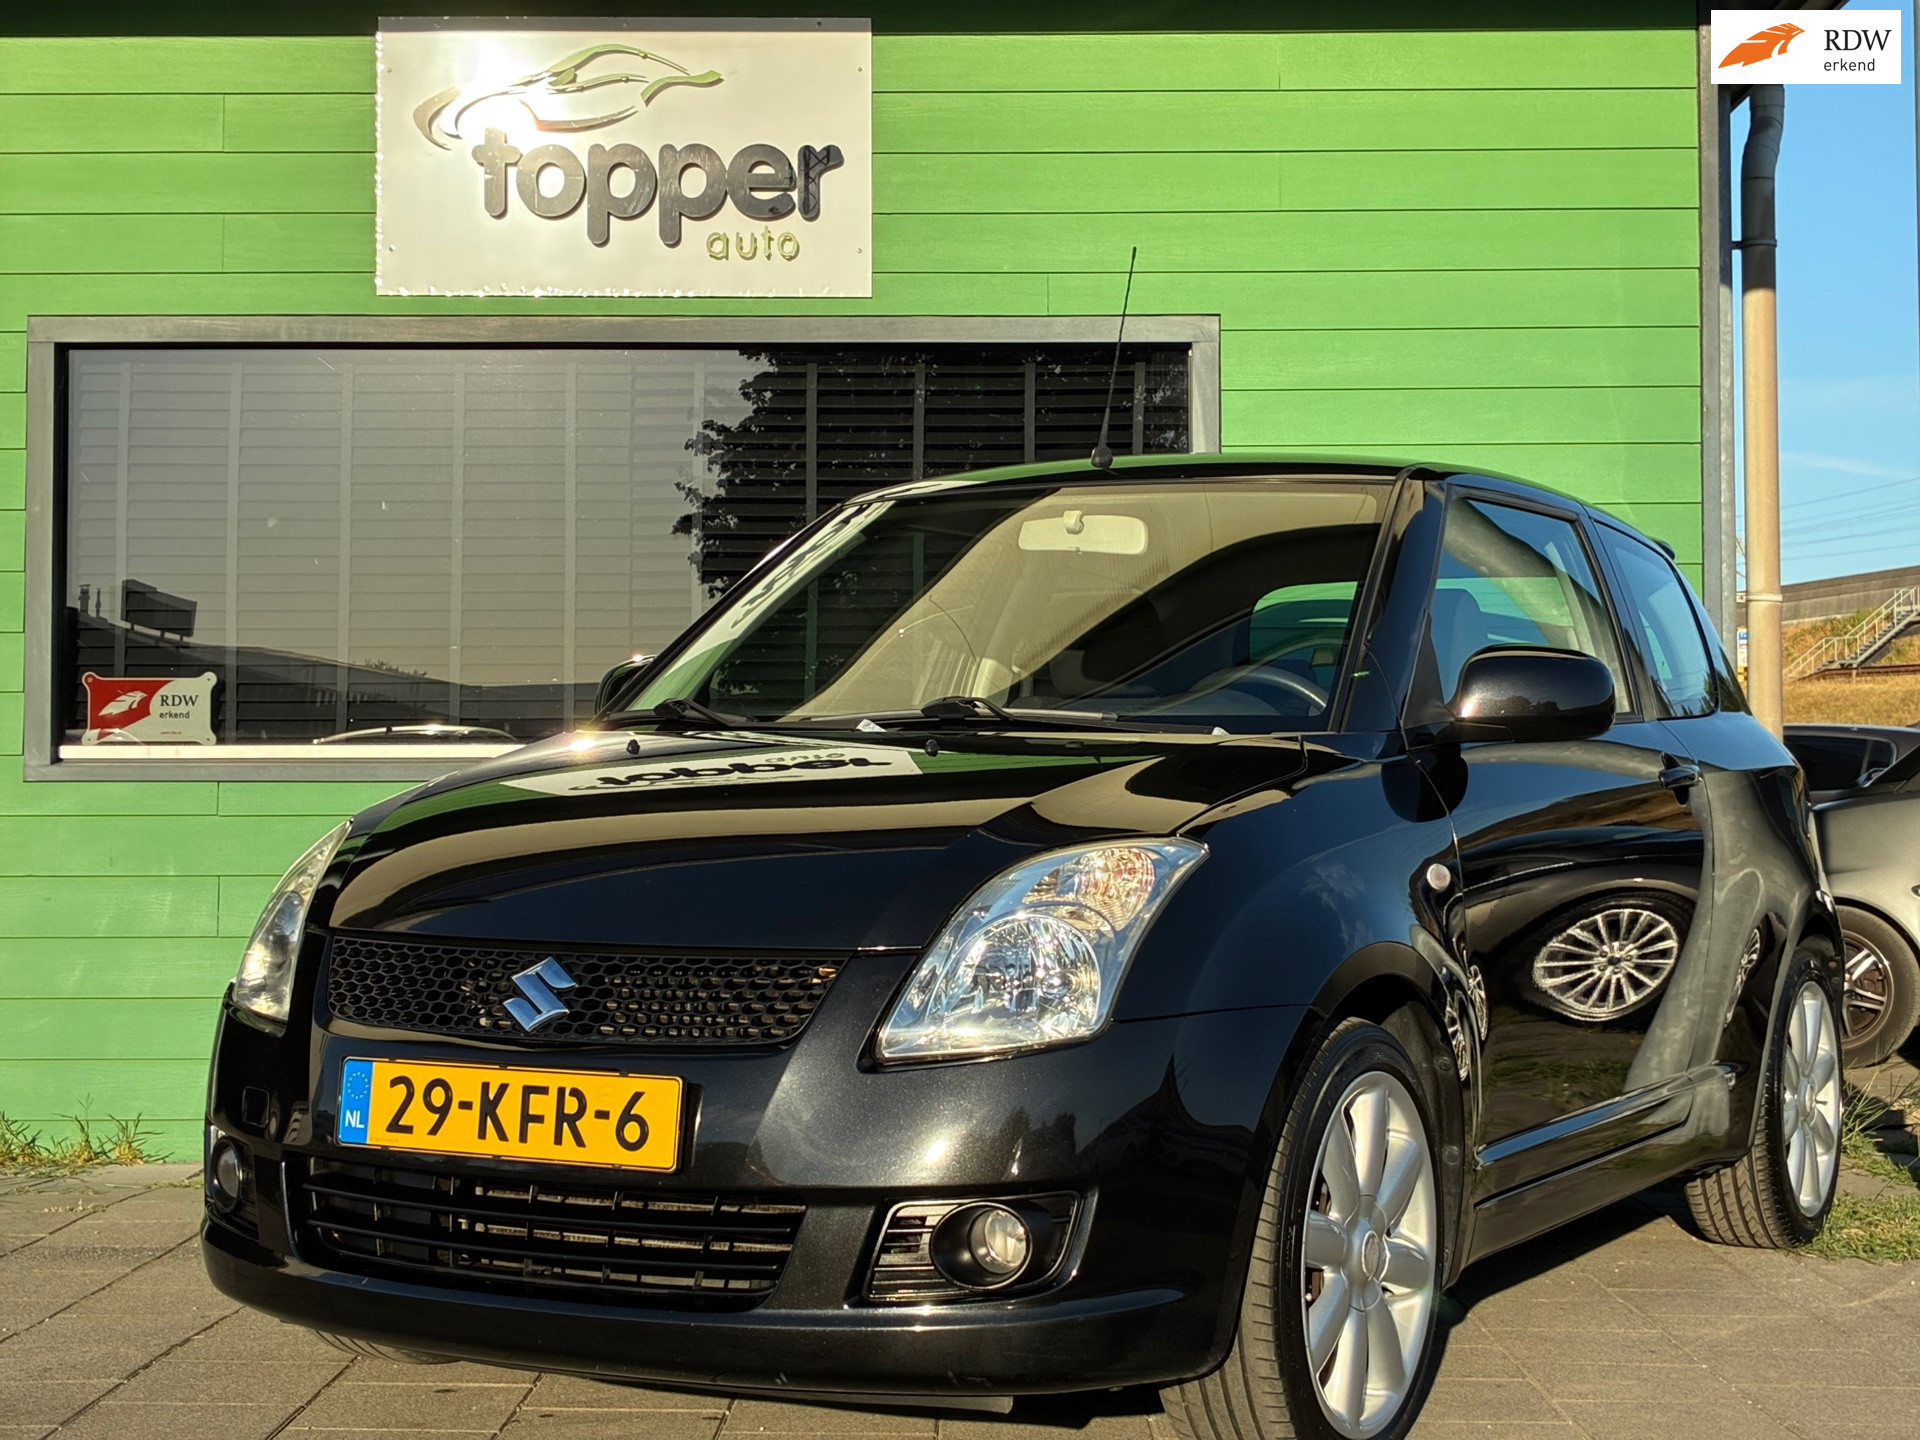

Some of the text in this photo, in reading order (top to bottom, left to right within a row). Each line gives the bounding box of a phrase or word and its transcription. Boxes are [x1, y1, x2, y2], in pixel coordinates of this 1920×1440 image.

[471, 127, 843, 246] topper
[706, 226, 800, 260] auto
[160, 694, 199, 707] RDW
[159, 711, 190, 719] erkend
[345, 1109, 365, 1129] NL
[385, 1075, 650, 1152] 29-KFR-6
